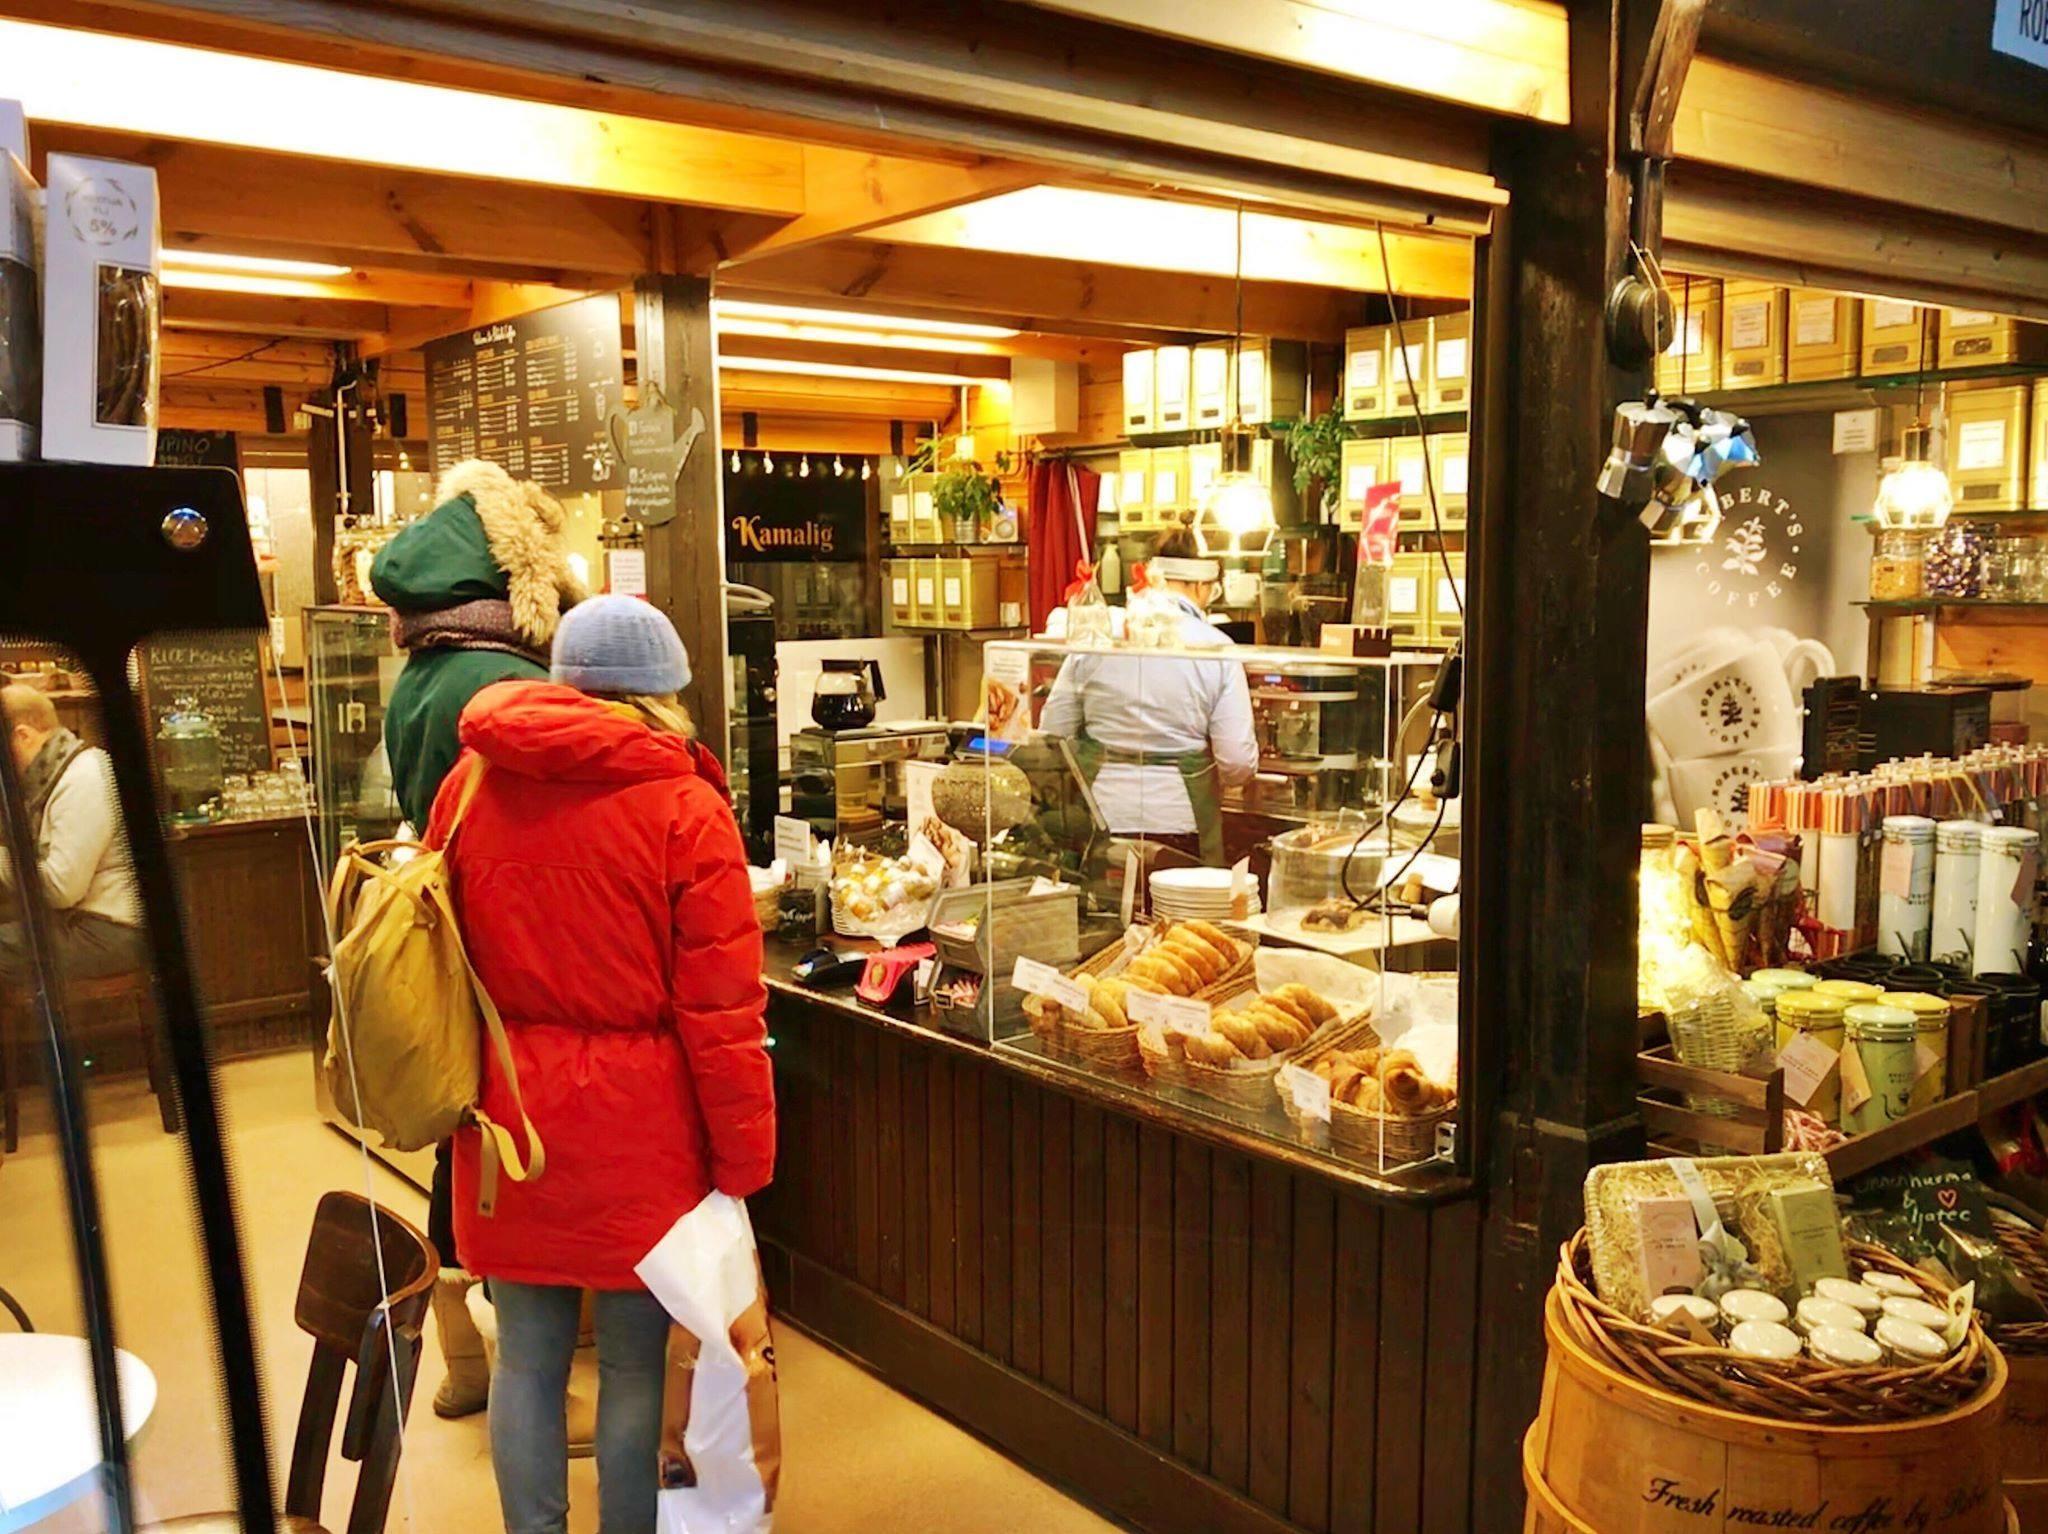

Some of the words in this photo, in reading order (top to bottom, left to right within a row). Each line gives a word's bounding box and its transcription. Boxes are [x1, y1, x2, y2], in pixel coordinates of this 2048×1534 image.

[732, 515, 834, 552] Kamalig
[1696, 562, 1797, 607] COFFEE
[1641, 1477, 1721, 1516] Fresh
[1726, 1500, 1829, 1529] roasted
[1829, 1497, 1895, 1534] coffee
